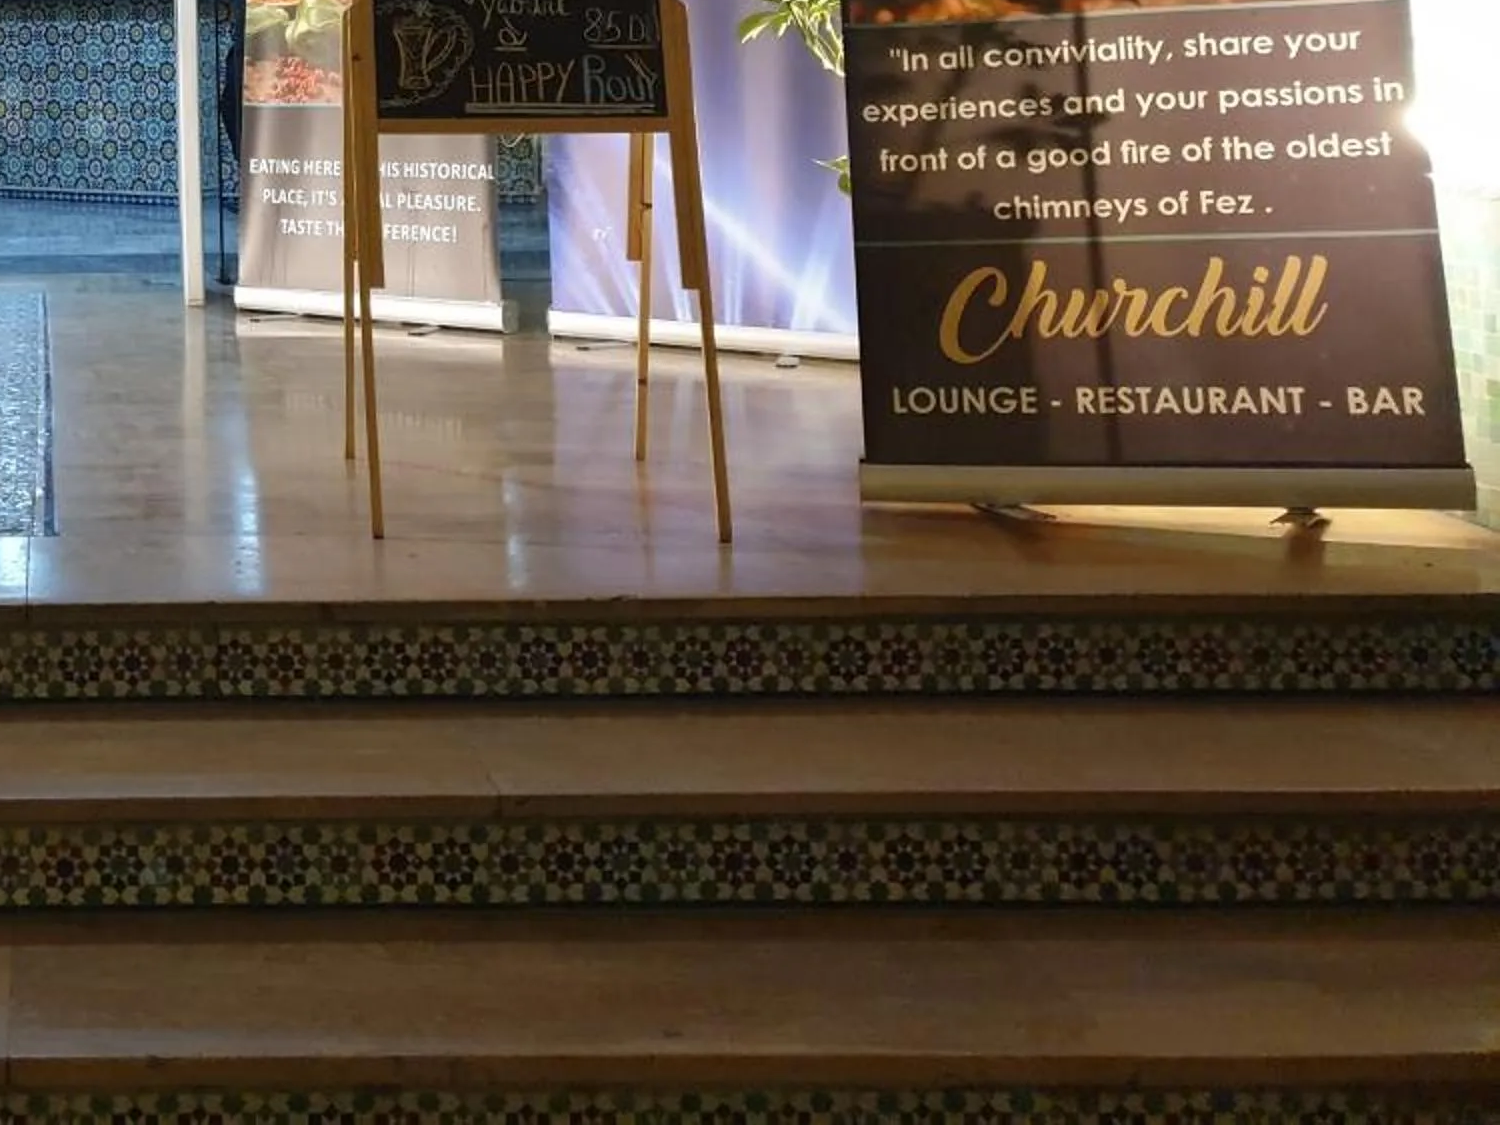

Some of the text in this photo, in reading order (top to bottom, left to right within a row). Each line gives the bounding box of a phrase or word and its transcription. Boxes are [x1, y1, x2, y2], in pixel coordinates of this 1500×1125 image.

[583, 7, 622, 43] 85
[939, 47, 974, 71] all
[983, 36, 1173, 68] conviviality,
[1184, 32, 1273, 60] share
[1284, 28, 1361, 59] your
[470, 59, 576, 104] HAPPY
[862, 77, 1404, 126] experiences and your passions in
[250, 158, 301, 176] EATING
[304, 159, 341, 177] HERE
[403, 162, 495, 181] HISTORICAL
[879, 131, 1392, 173] front of a good fire of the oldest
[262, 188, 308, 207] PLACE,
[311, 189, 337, 207] IT'S
[397, 193, 481, 212] PLEASURE.
[994, 191, 1148, 222] chimneys
[1158, 190, 1190, 216] of
[1201, 190, 1255, 216] Fez
[280, 218, 324, 237] TASTE
[384, 224, 458, 243] FERENCE!
[939, 255, 1328, 364] Churchill
[893, 386, 1037, 415] LOUNGE
[1076, 386, 1306, 415] RESTAURANT
[1347, 387, 1426, 416] BAR
